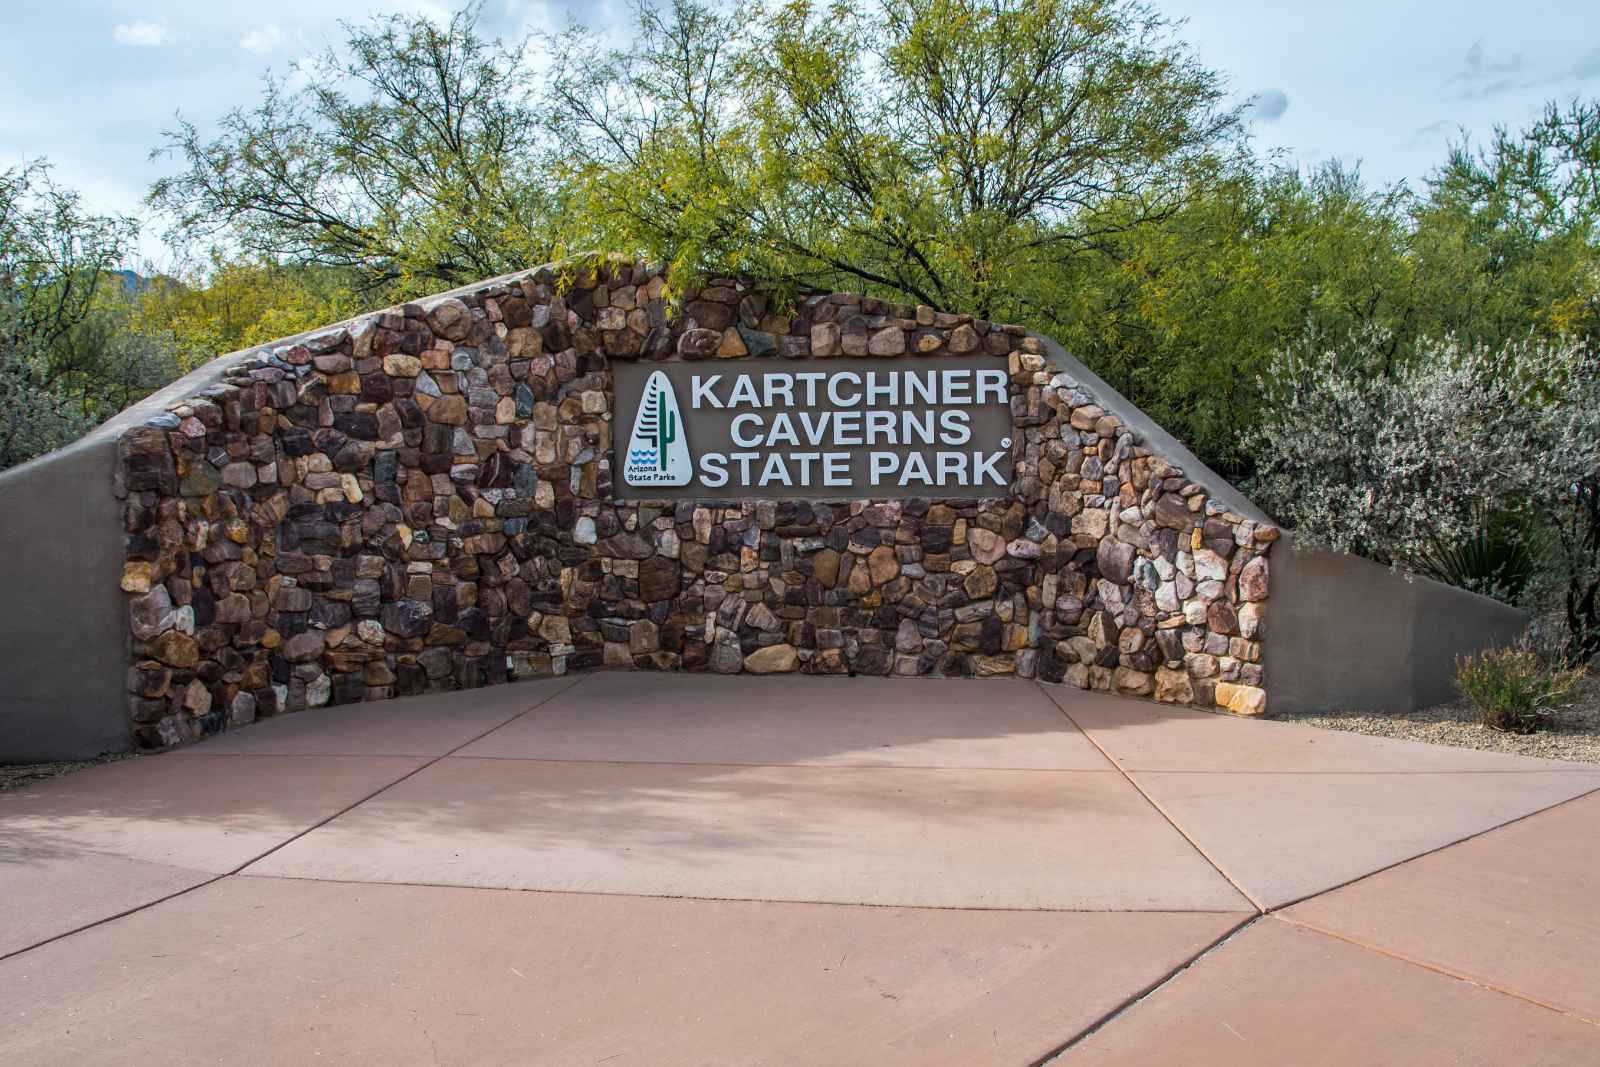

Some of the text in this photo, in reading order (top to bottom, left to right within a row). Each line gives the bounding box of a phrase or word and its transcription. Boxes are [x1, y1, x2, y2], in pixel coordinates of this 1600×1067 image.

[691, 370, 1008, 409] KARTCHNER
[730, 409, 971, 448] CAVERNS
[627, 465, 657, 473] Arizona
[653, 473, 675, 481] Parks
[699, 451, 1007, 487] STATE PARK
